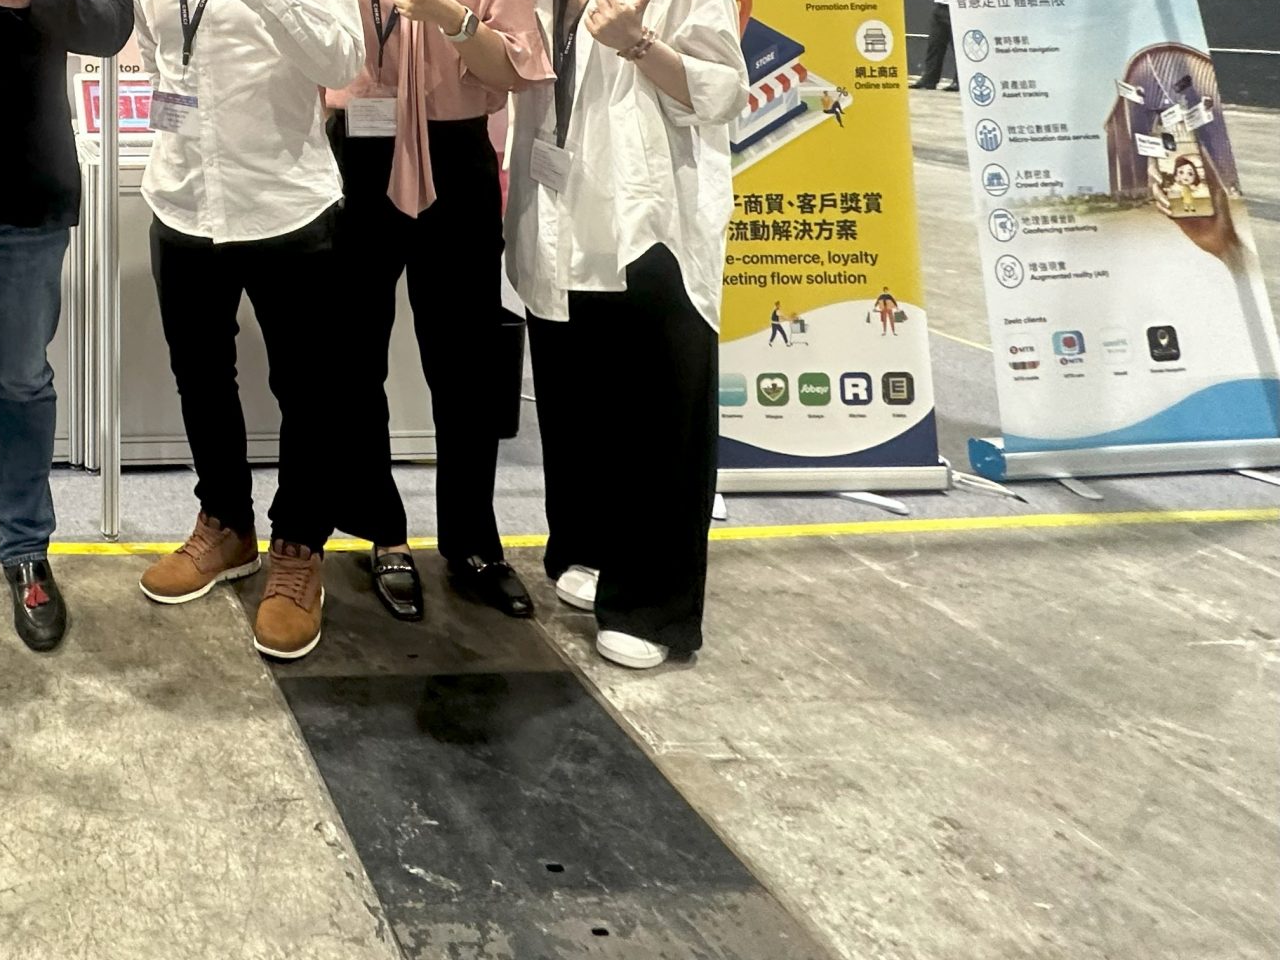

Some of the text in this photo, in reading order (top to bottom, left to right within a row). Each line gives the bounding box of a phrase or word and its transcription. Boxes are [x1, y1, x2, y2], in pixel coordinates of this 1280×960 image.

[805, 2, 878, 12] Promotion Engine
[855, 81, 900, 90] Online store
[728, 219, 858, 241] 流動解決方案
[725, 250, 879, 266] e-commerce, loyalty
[770, 271, 802, 285] flow
[806, 270, 867, 285] solution
[843, 377, 868, 401] R
